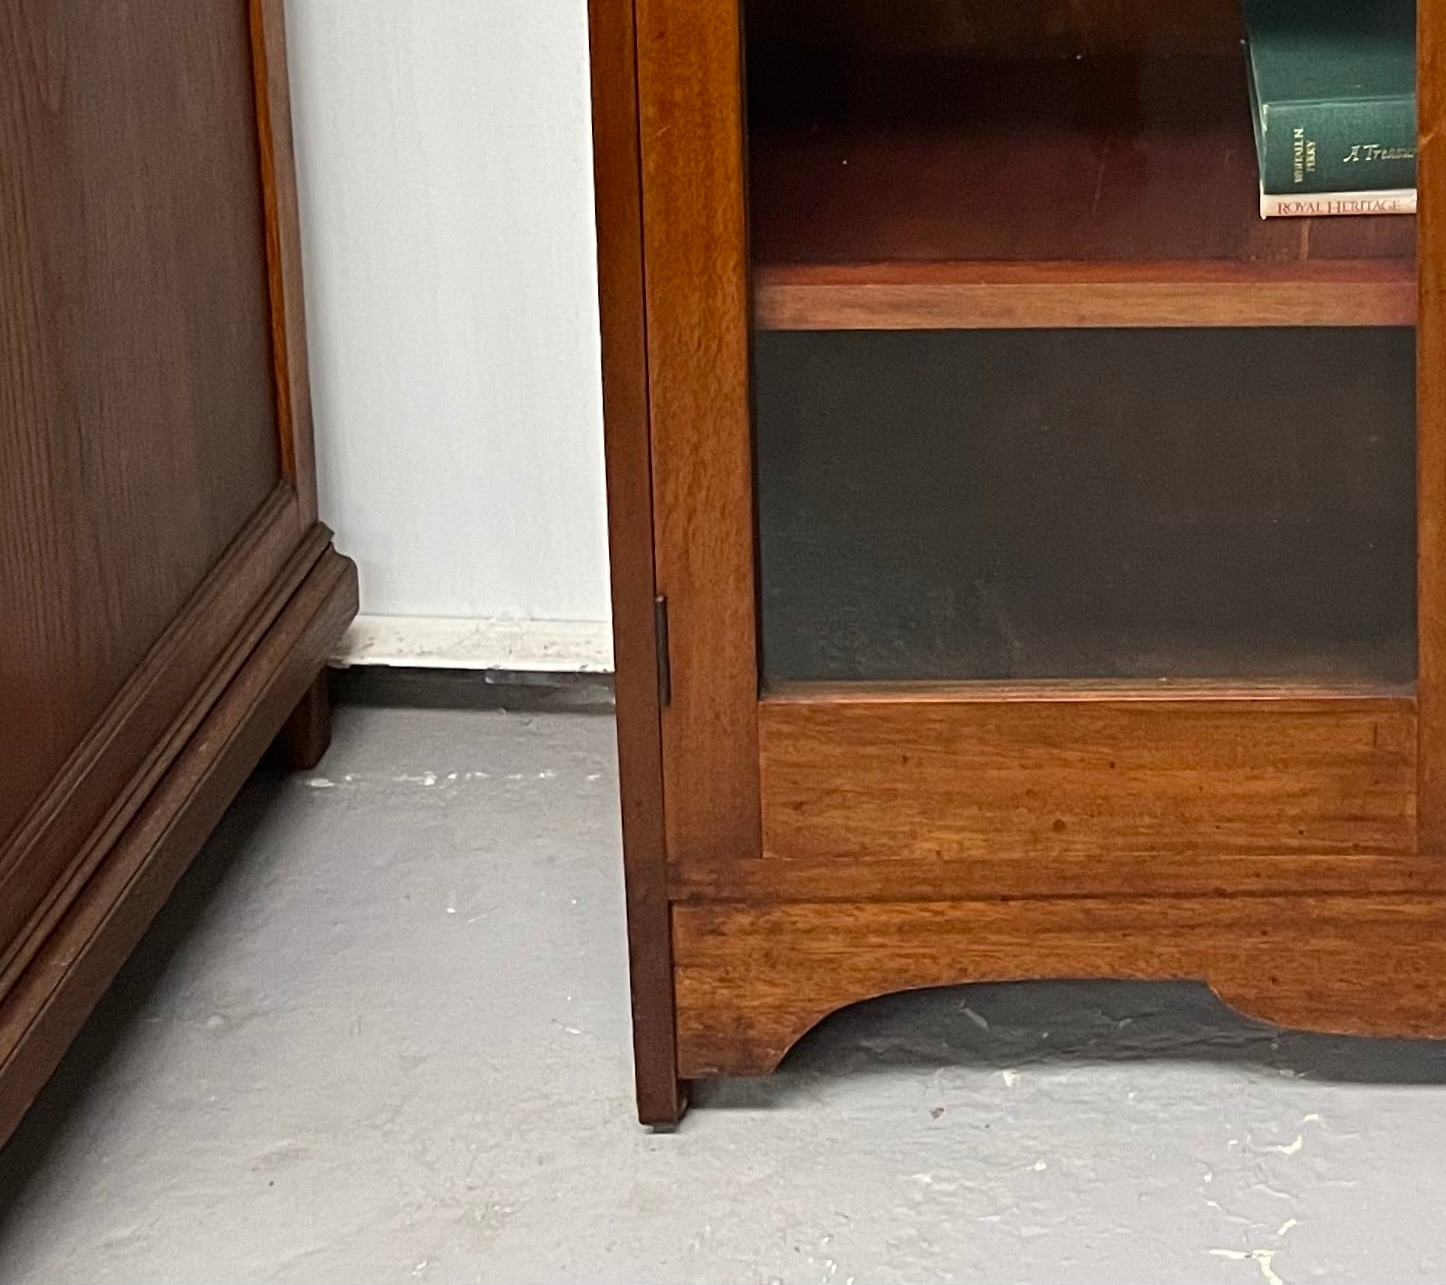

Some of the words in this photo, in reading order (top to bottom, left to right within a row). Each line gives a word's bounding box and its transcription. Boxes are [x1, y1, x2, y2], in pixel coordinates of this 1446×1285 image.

[1343, 144, 1361, 163] A
[1278, 200, 1324, 215] ROYAL
[1327, 200, 1402, 214] HERITAGE
